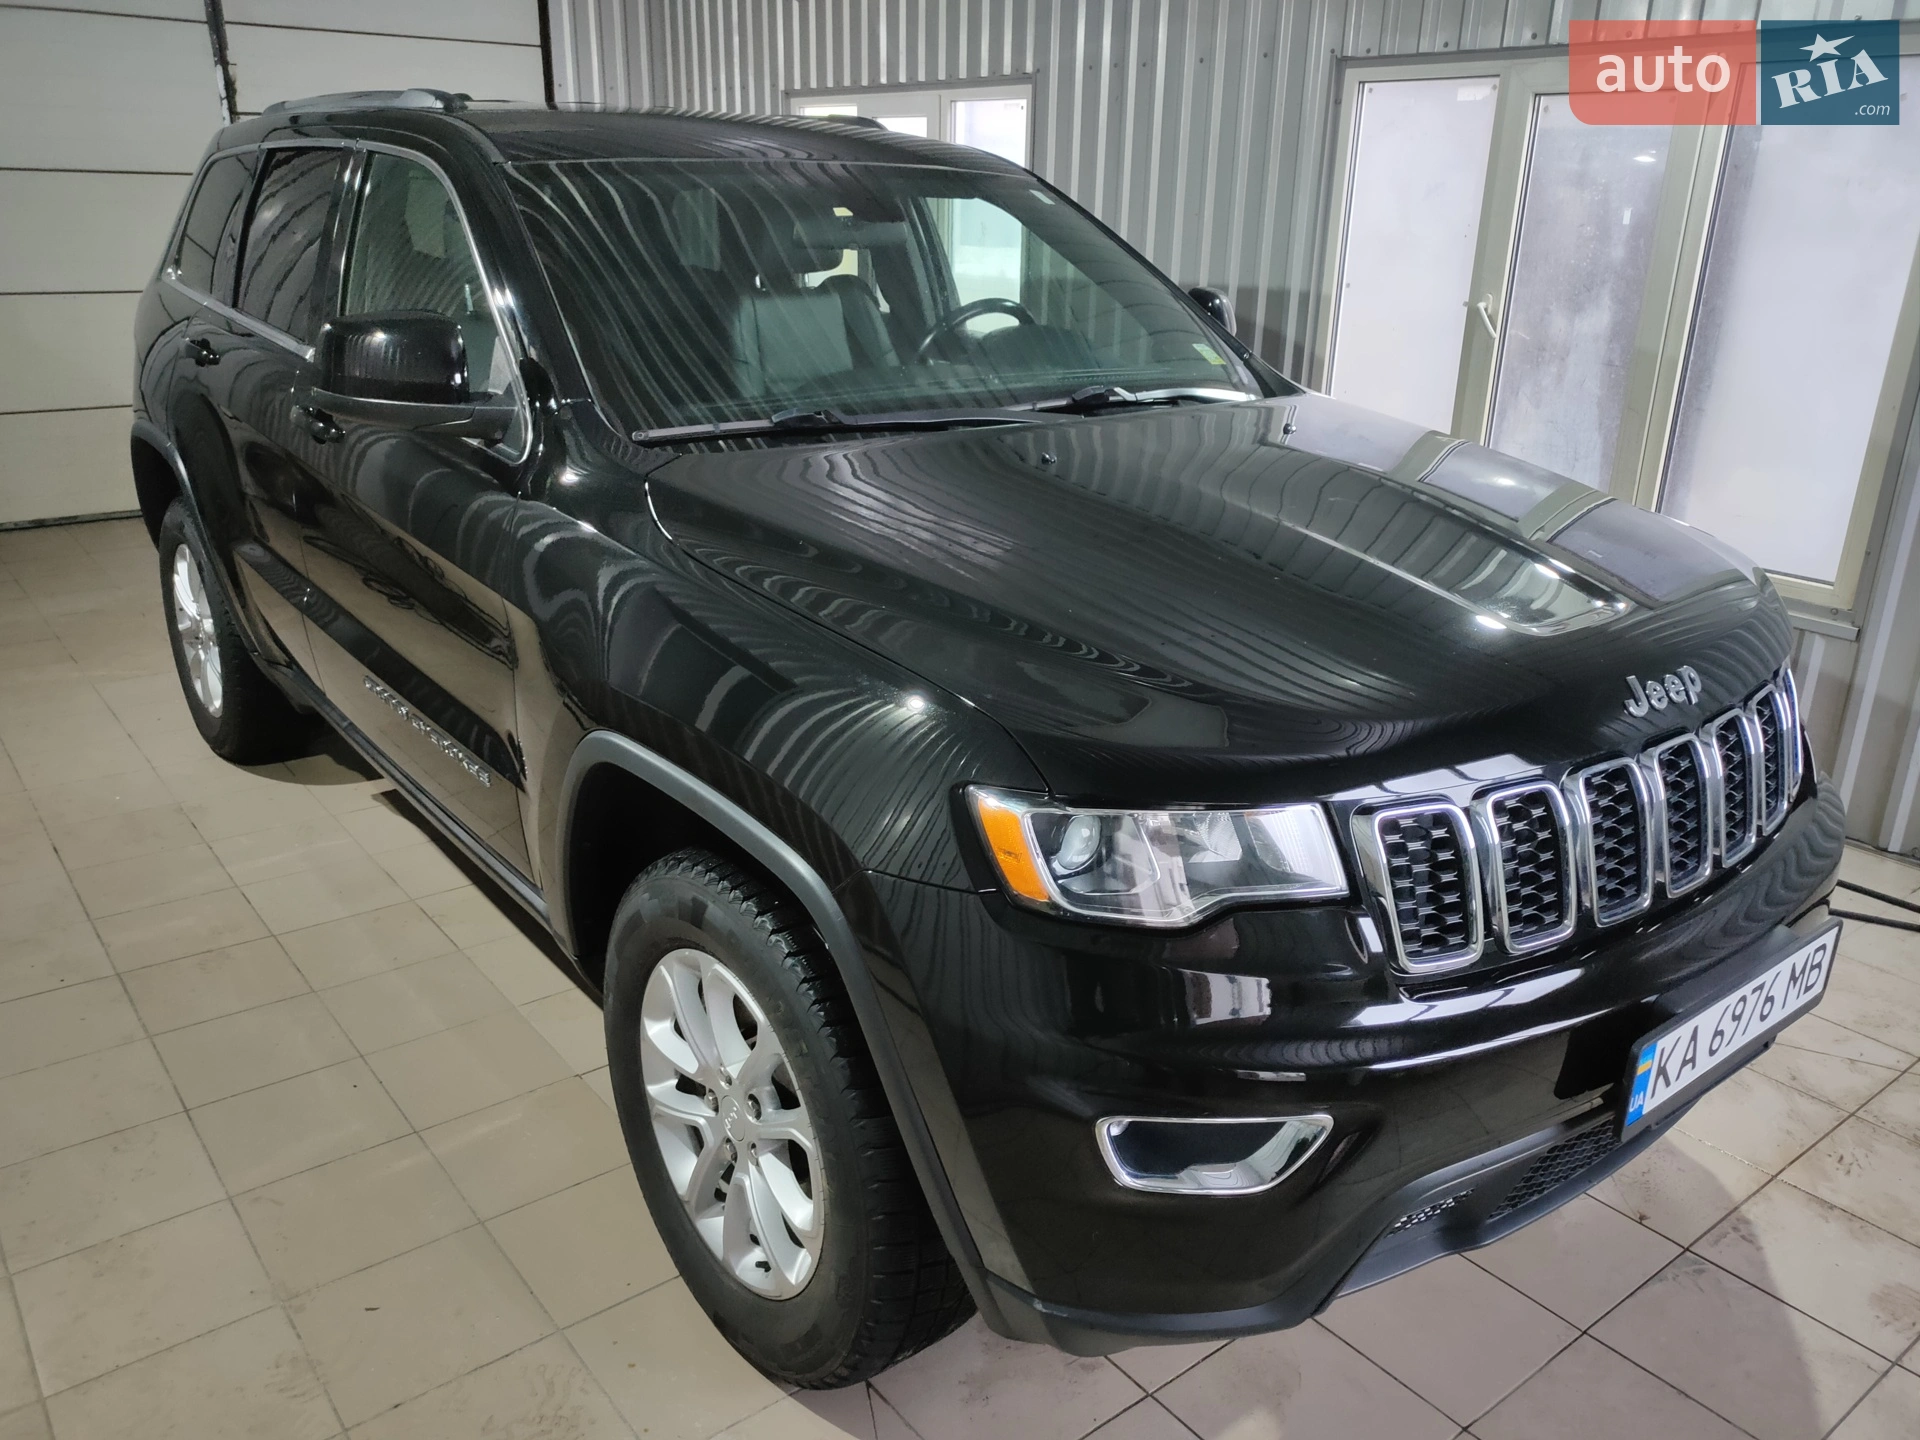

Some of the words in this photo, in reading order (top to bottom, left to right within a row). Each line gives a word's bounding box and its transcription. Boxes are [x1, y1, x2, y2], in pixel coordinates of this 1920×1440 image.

[1624, 665, 1702, 718] Jeep
[1650, 1024, 1699, 1100] KA
[1708, 970, 1782, 1058] 6976
[1781, 942, 1828, 1011] MB
[1629, 1091, 1644, 1112] UA
